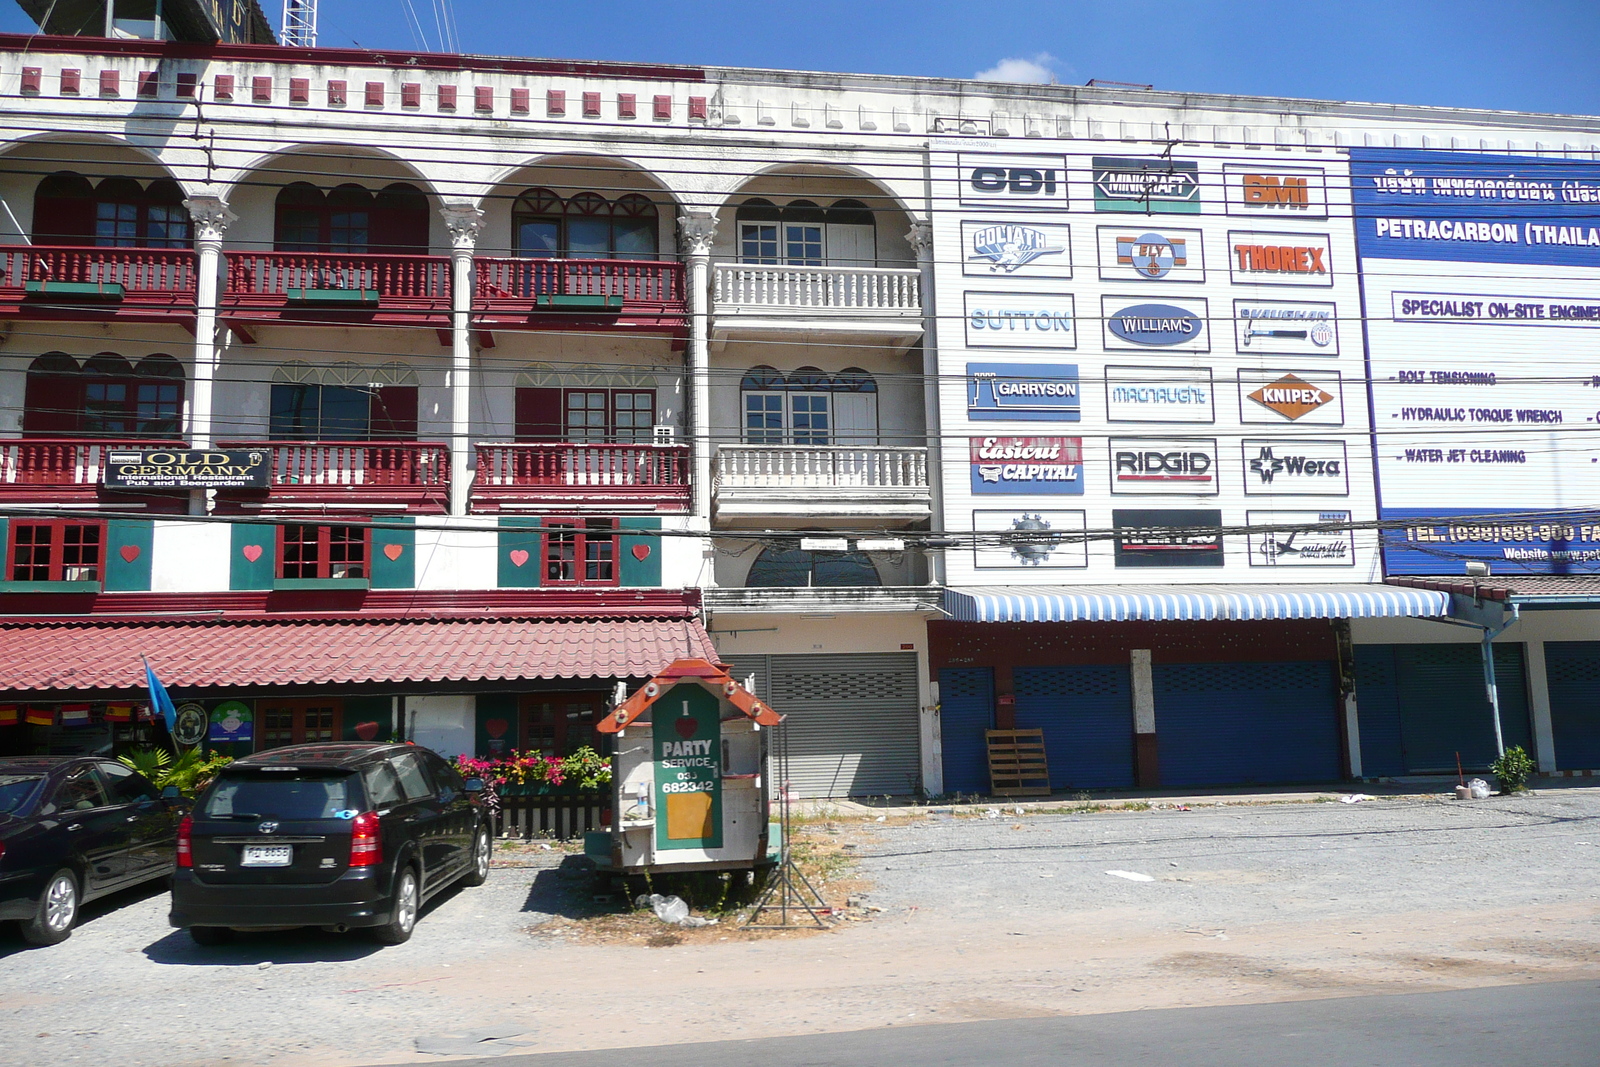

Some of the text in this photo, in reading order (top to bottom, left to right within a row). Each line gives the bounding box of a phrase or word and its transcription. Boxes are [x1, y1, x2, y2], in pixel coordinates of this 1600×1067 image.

[971, 168, 1056, 195] CDI
[1108, 172, 1186, 195] MINICRAFT
[1243, 174, 1309, 208] BMI
[974, 225, 1046, 249] GOLIATH
[1376, 218, 1518, 243] PETRACARBON
[1139, 244, 1165, 257] ELY
[1235, 245, 1326, 274] THOREX
[1251, 309, 1329, 323] VAUGHAN
[1402, 299, 1600, 321] SPECIALIST ON-SITE ENGINE
[971, 307, 1071, 333] SUTTON
[1121, 314, 1194, 335] WILLIAMS
[1399, 370, 1497, 385] BOLT TENSIONING
[999, 382, 1076, 399] GARRYSON
[1262, 388, 1323, 406] KNIPEX
[1401, 407, 1562, 424] HYDRAULIC TORQUE WRENCH
[979, 437, 1060, 460] Easicut
[1405, 448, 1526, 464] WATER JET CLEANING
[146, 452, 230, 466] OLD
[1116, 451, 1212, 475] RIDGID
[1284, 455, 1341, 476] Wera
[119, 465, 253, 476] GERMANY
[1002, 464, 1078, 482] CAPITAL
[1406, 525, 1445, 542] TEL.
[1503, 547, 1548, 561] Website
[682, 700, 690, 716] I
[662, 739, 712, 758] PARTY
[662, 757, 711, 769] SERVICE
[662, 780, 714, 793] 682342
